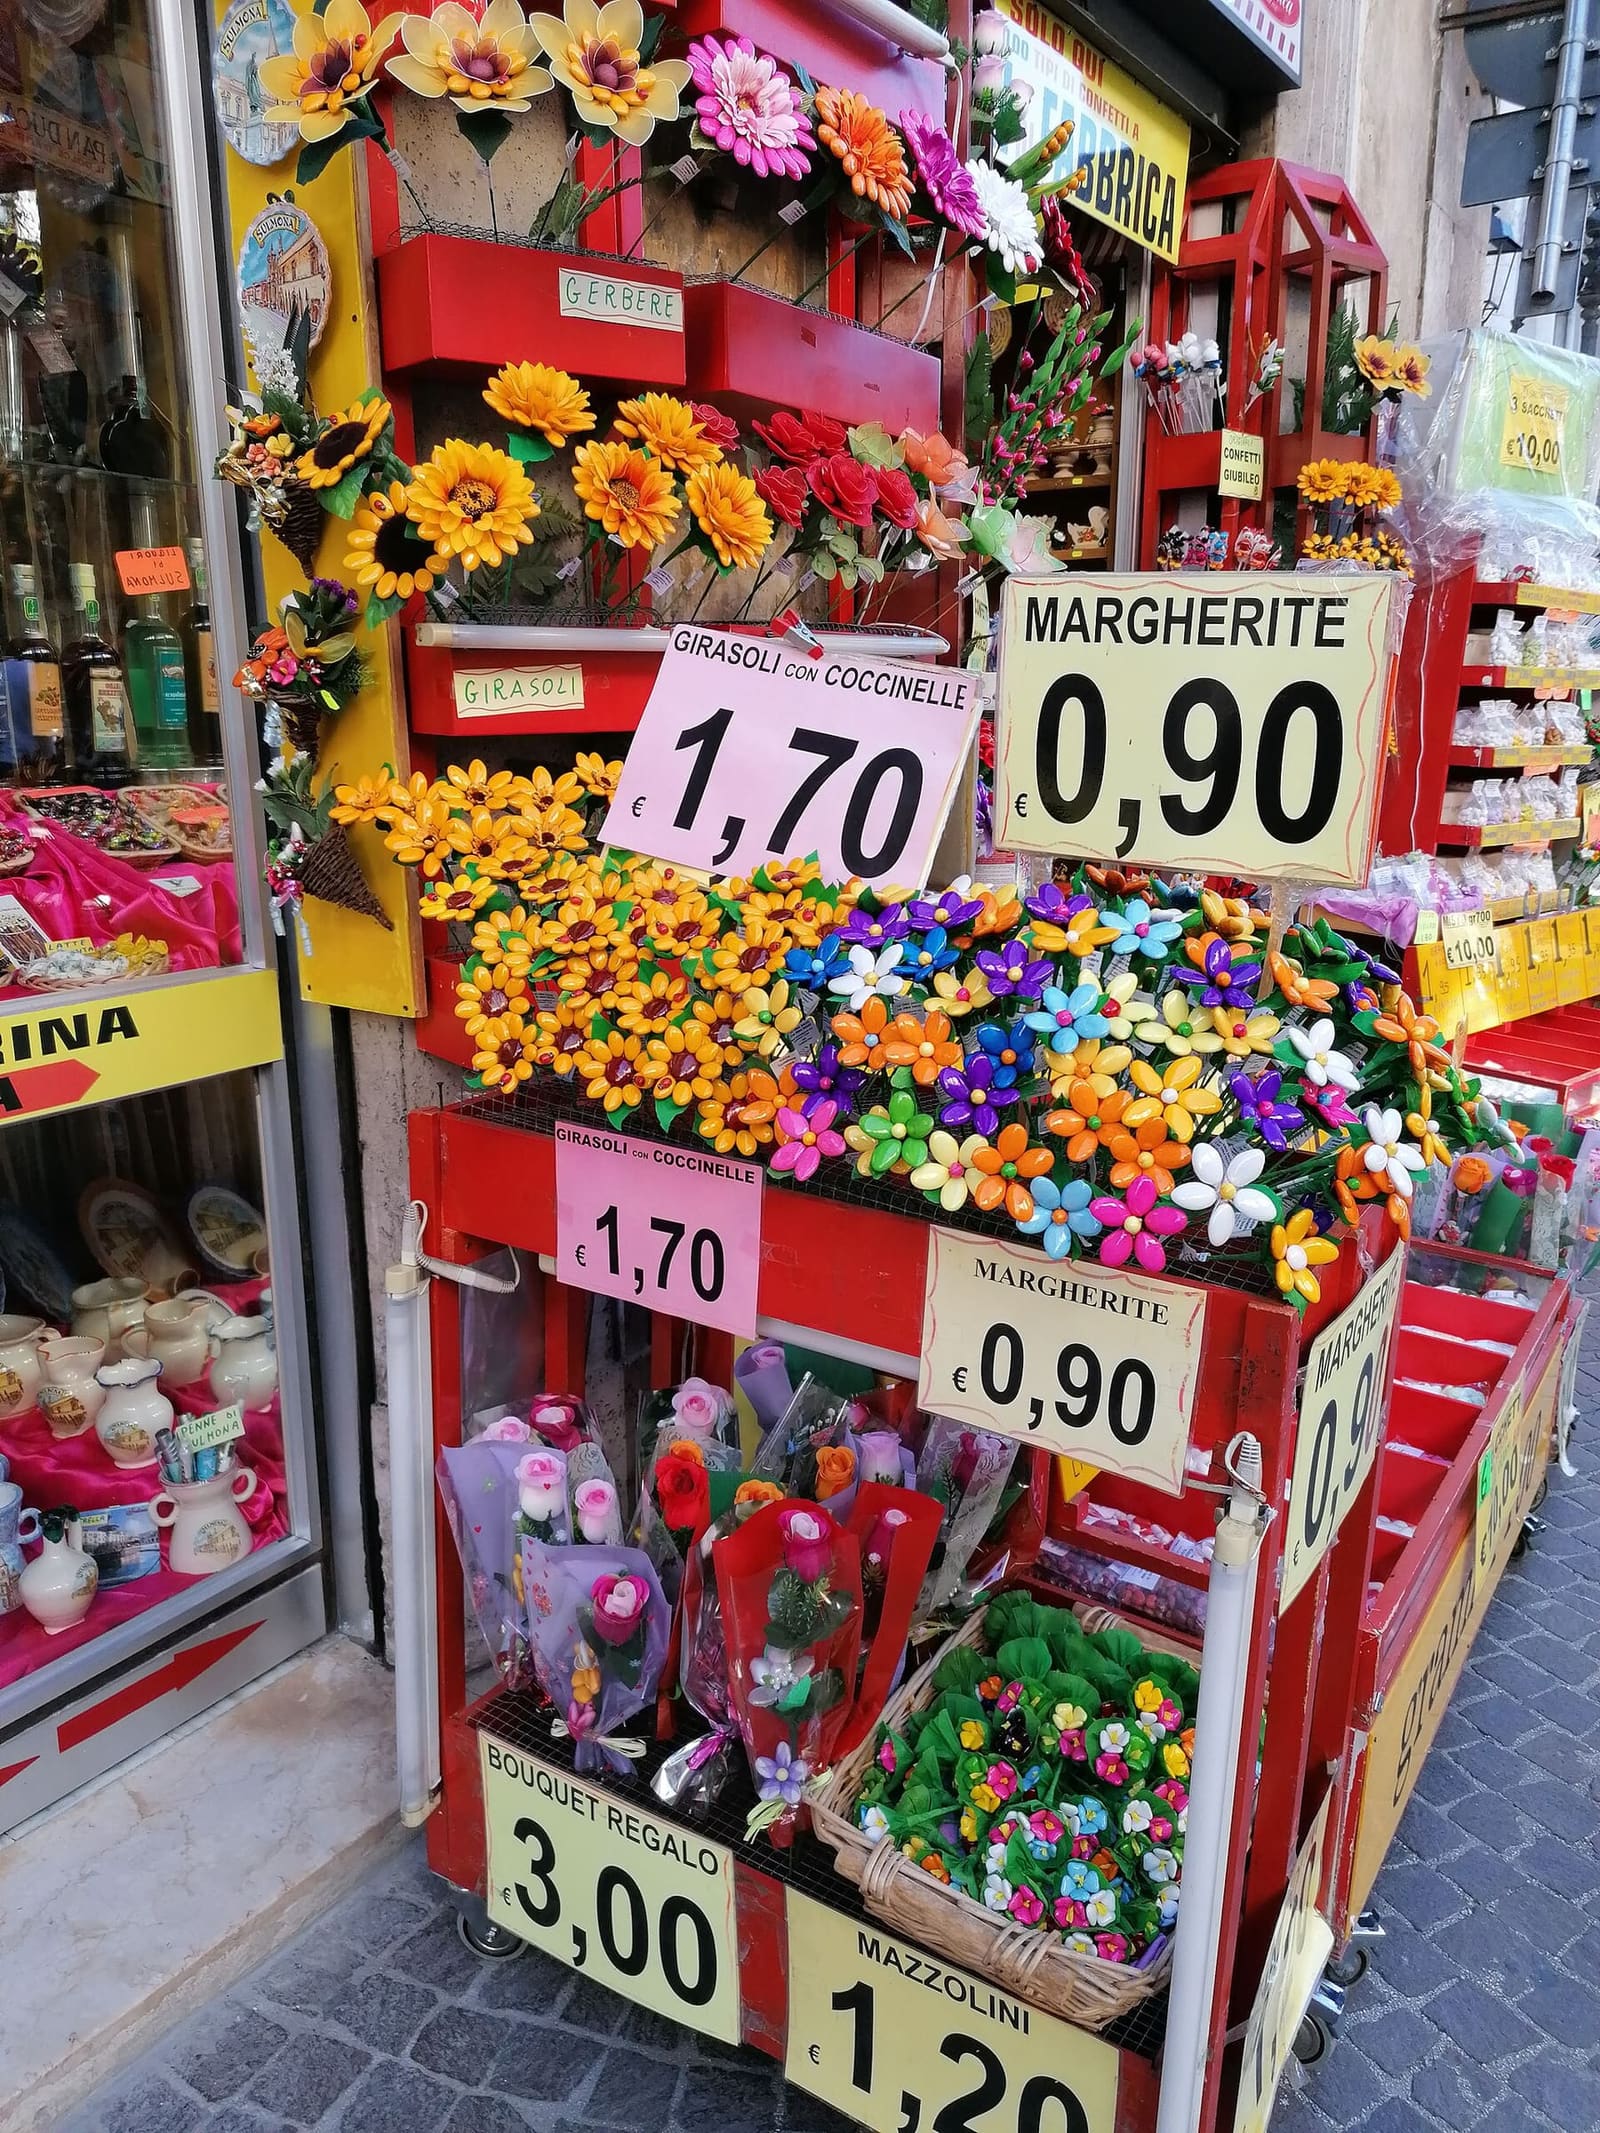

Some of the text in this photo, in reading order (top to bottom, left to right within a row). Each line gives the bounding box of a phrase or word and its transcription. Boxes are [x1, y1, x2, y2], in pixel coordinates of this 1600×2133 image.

[1009, 0, 1066, 54] SOLO
[1072, 38, 1106, 89] QUI
[1033, 53, 1058, 82] TIPI
[1063, 69, 1076, 92] DI
[1080, 82, 1131, 135] CONFETTI
[1131, 122, 1140, 141] A
[1041, 87, 1177, 254] FABBRICA
[256, 215, 294, 239] SULMONA
[566, 276, 673, 318] GERBERE
[1223, 446, 1261, 465] CONFETTI
[1223, 468, 1260, 486] GIUBILEO
[1024, 596, 1349, 648] MARGHERITE
[464, 676, 576, 705] GIRASOLI
[673, 630, 968, 711] GIRASOLI CON COCCINELLE
[631, 707, 924, 879] € 1,70
[1014, 672, 1344, 859] € 0,90
[48, 939, 85, 951] LATTE
[0, 1005, 140, 1065] INA
[555, 1127, 755, 1184] GIRASOLI CON COCCINELLE
[574, 1205, 725, 1303] € 1,70
[972, 1258, 1170, 1326] MARGHERITE
[951, 1322, 1156, 1446] € 0,90
[180, 1412, 217, 1438] PENNE
[190, 1419, 240, 1448] ULMONA
[1304, 1322, 1390, 1549] 0,90
[487, 1743, 719, 1876] BOUQUET REGALO
[513, 1816, 718, 2007] 3,00
[856, 1930, 1031, 2036] MAZZOLINI
[807, 1980, 1090, 2133] € 1,20
